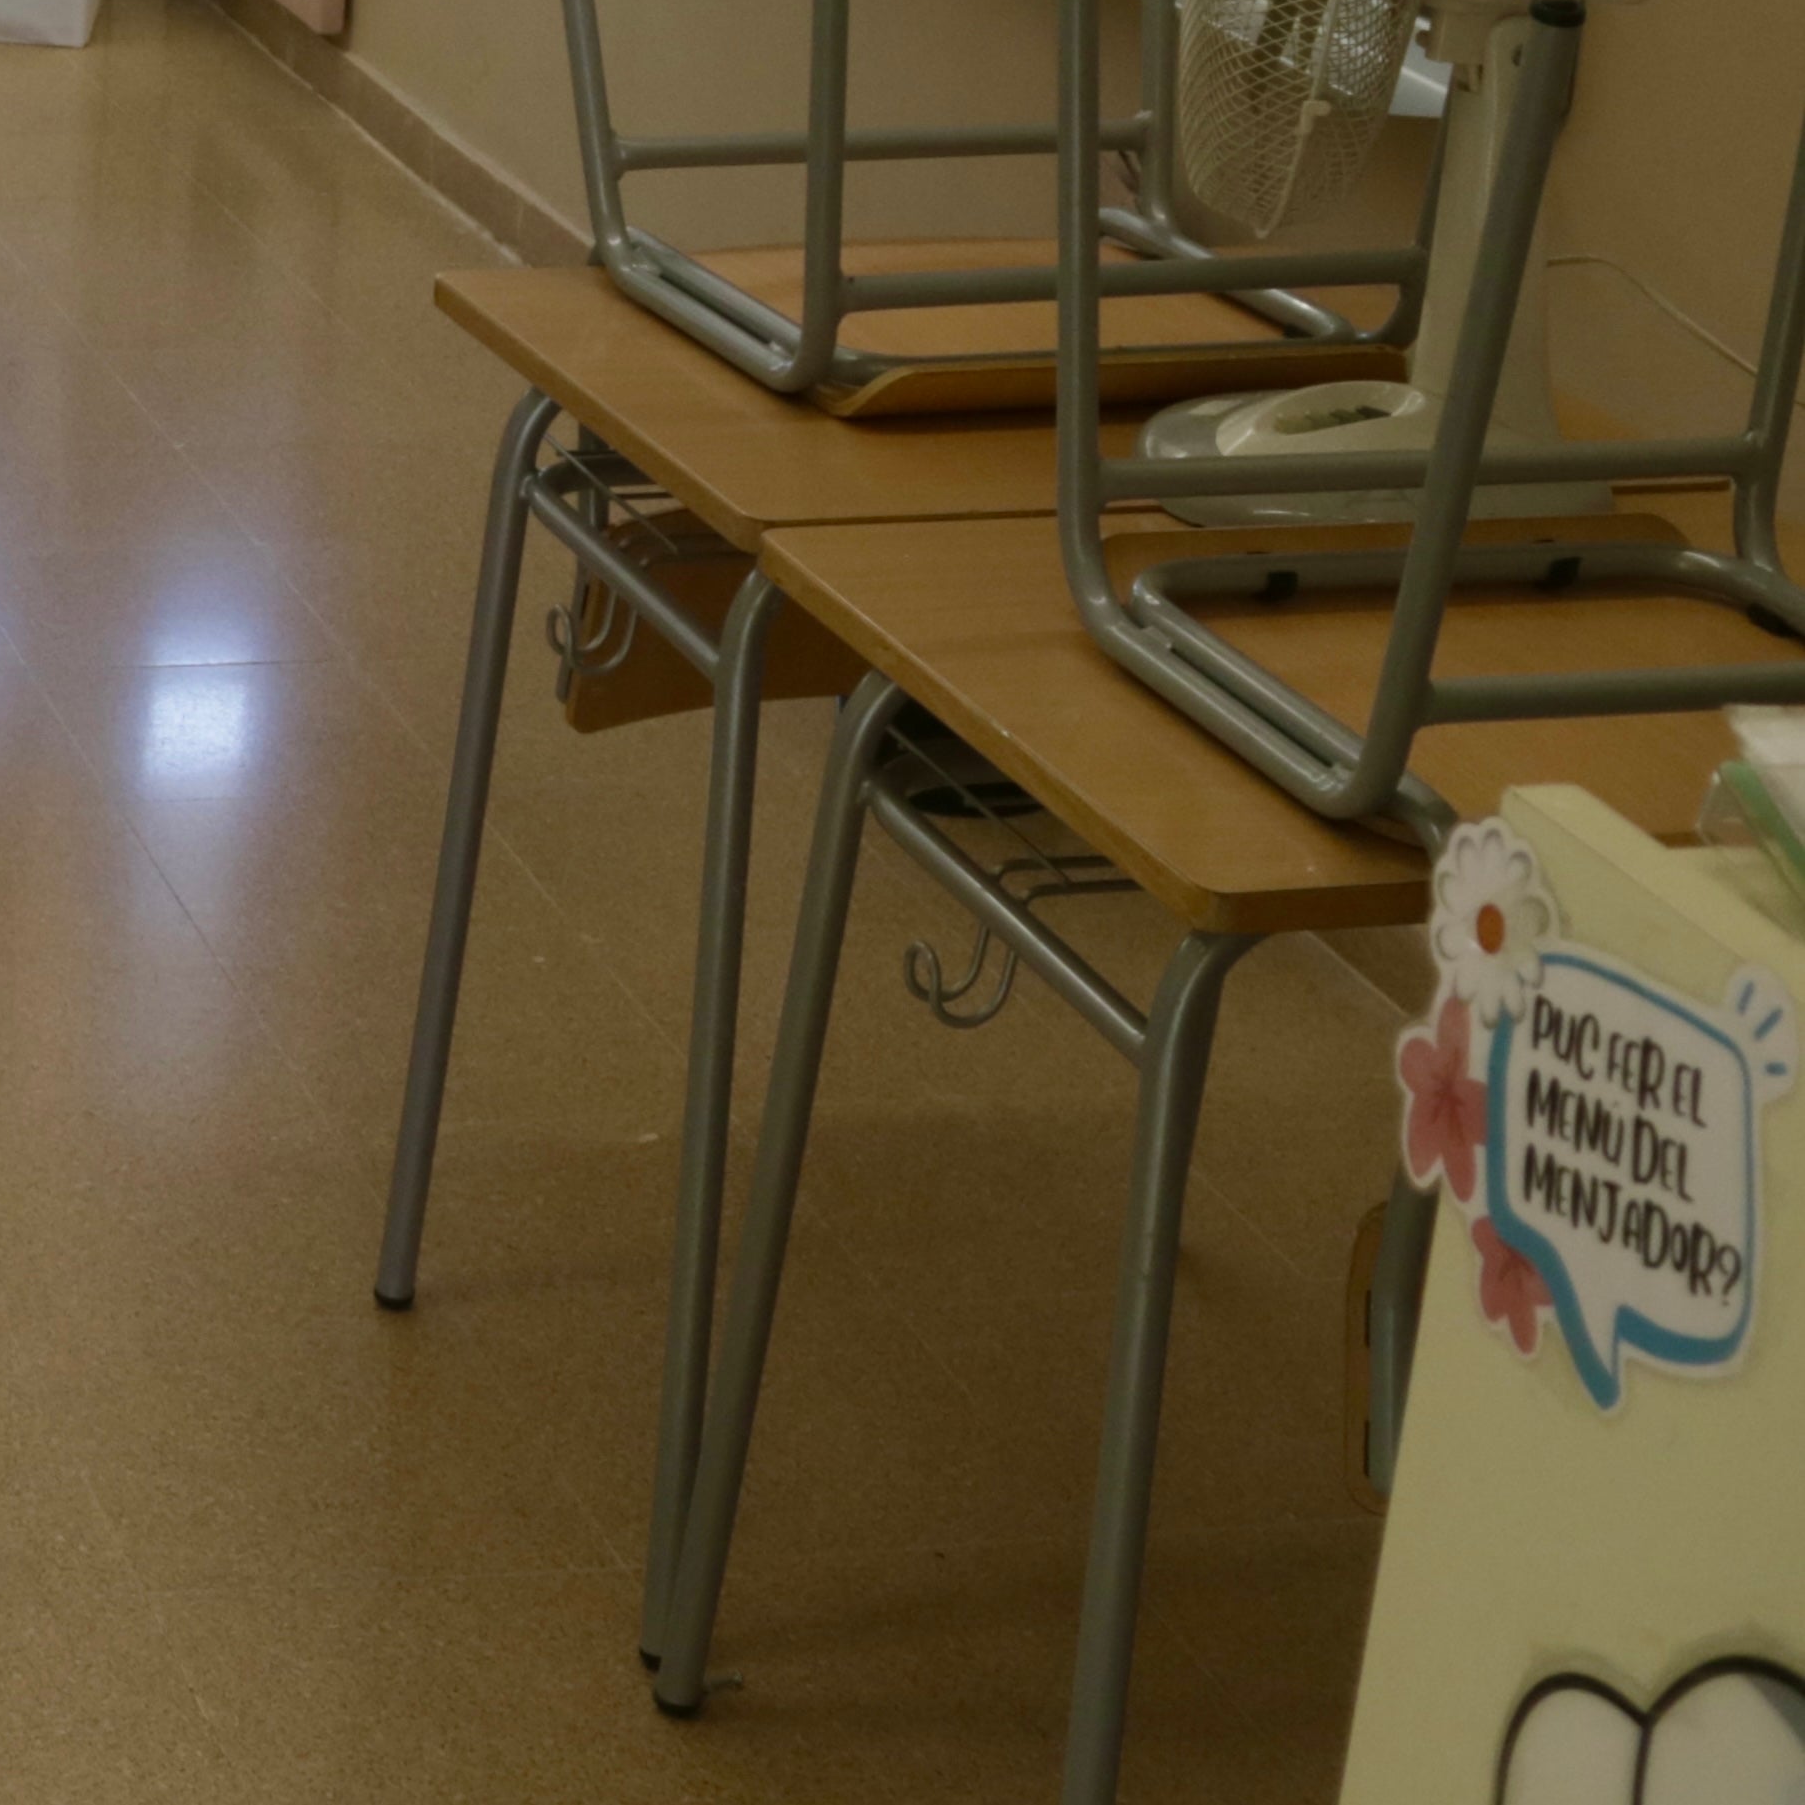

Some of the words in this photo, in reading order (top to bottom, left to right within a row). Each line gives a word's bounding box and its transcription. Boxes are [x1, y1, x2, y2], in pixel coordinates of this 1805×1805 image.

[1531, 994, 1598, 1081] PUC
[1605, 1030, 1666, 1111] FER
[1672, 1062, 1707, 1129] EL
[1523, 1068, 1625, 1167] MENÚ
[1631, 1114, 1695, 1204] DEL
[1522, 1142, 1744, 1307] MENJADOR?
